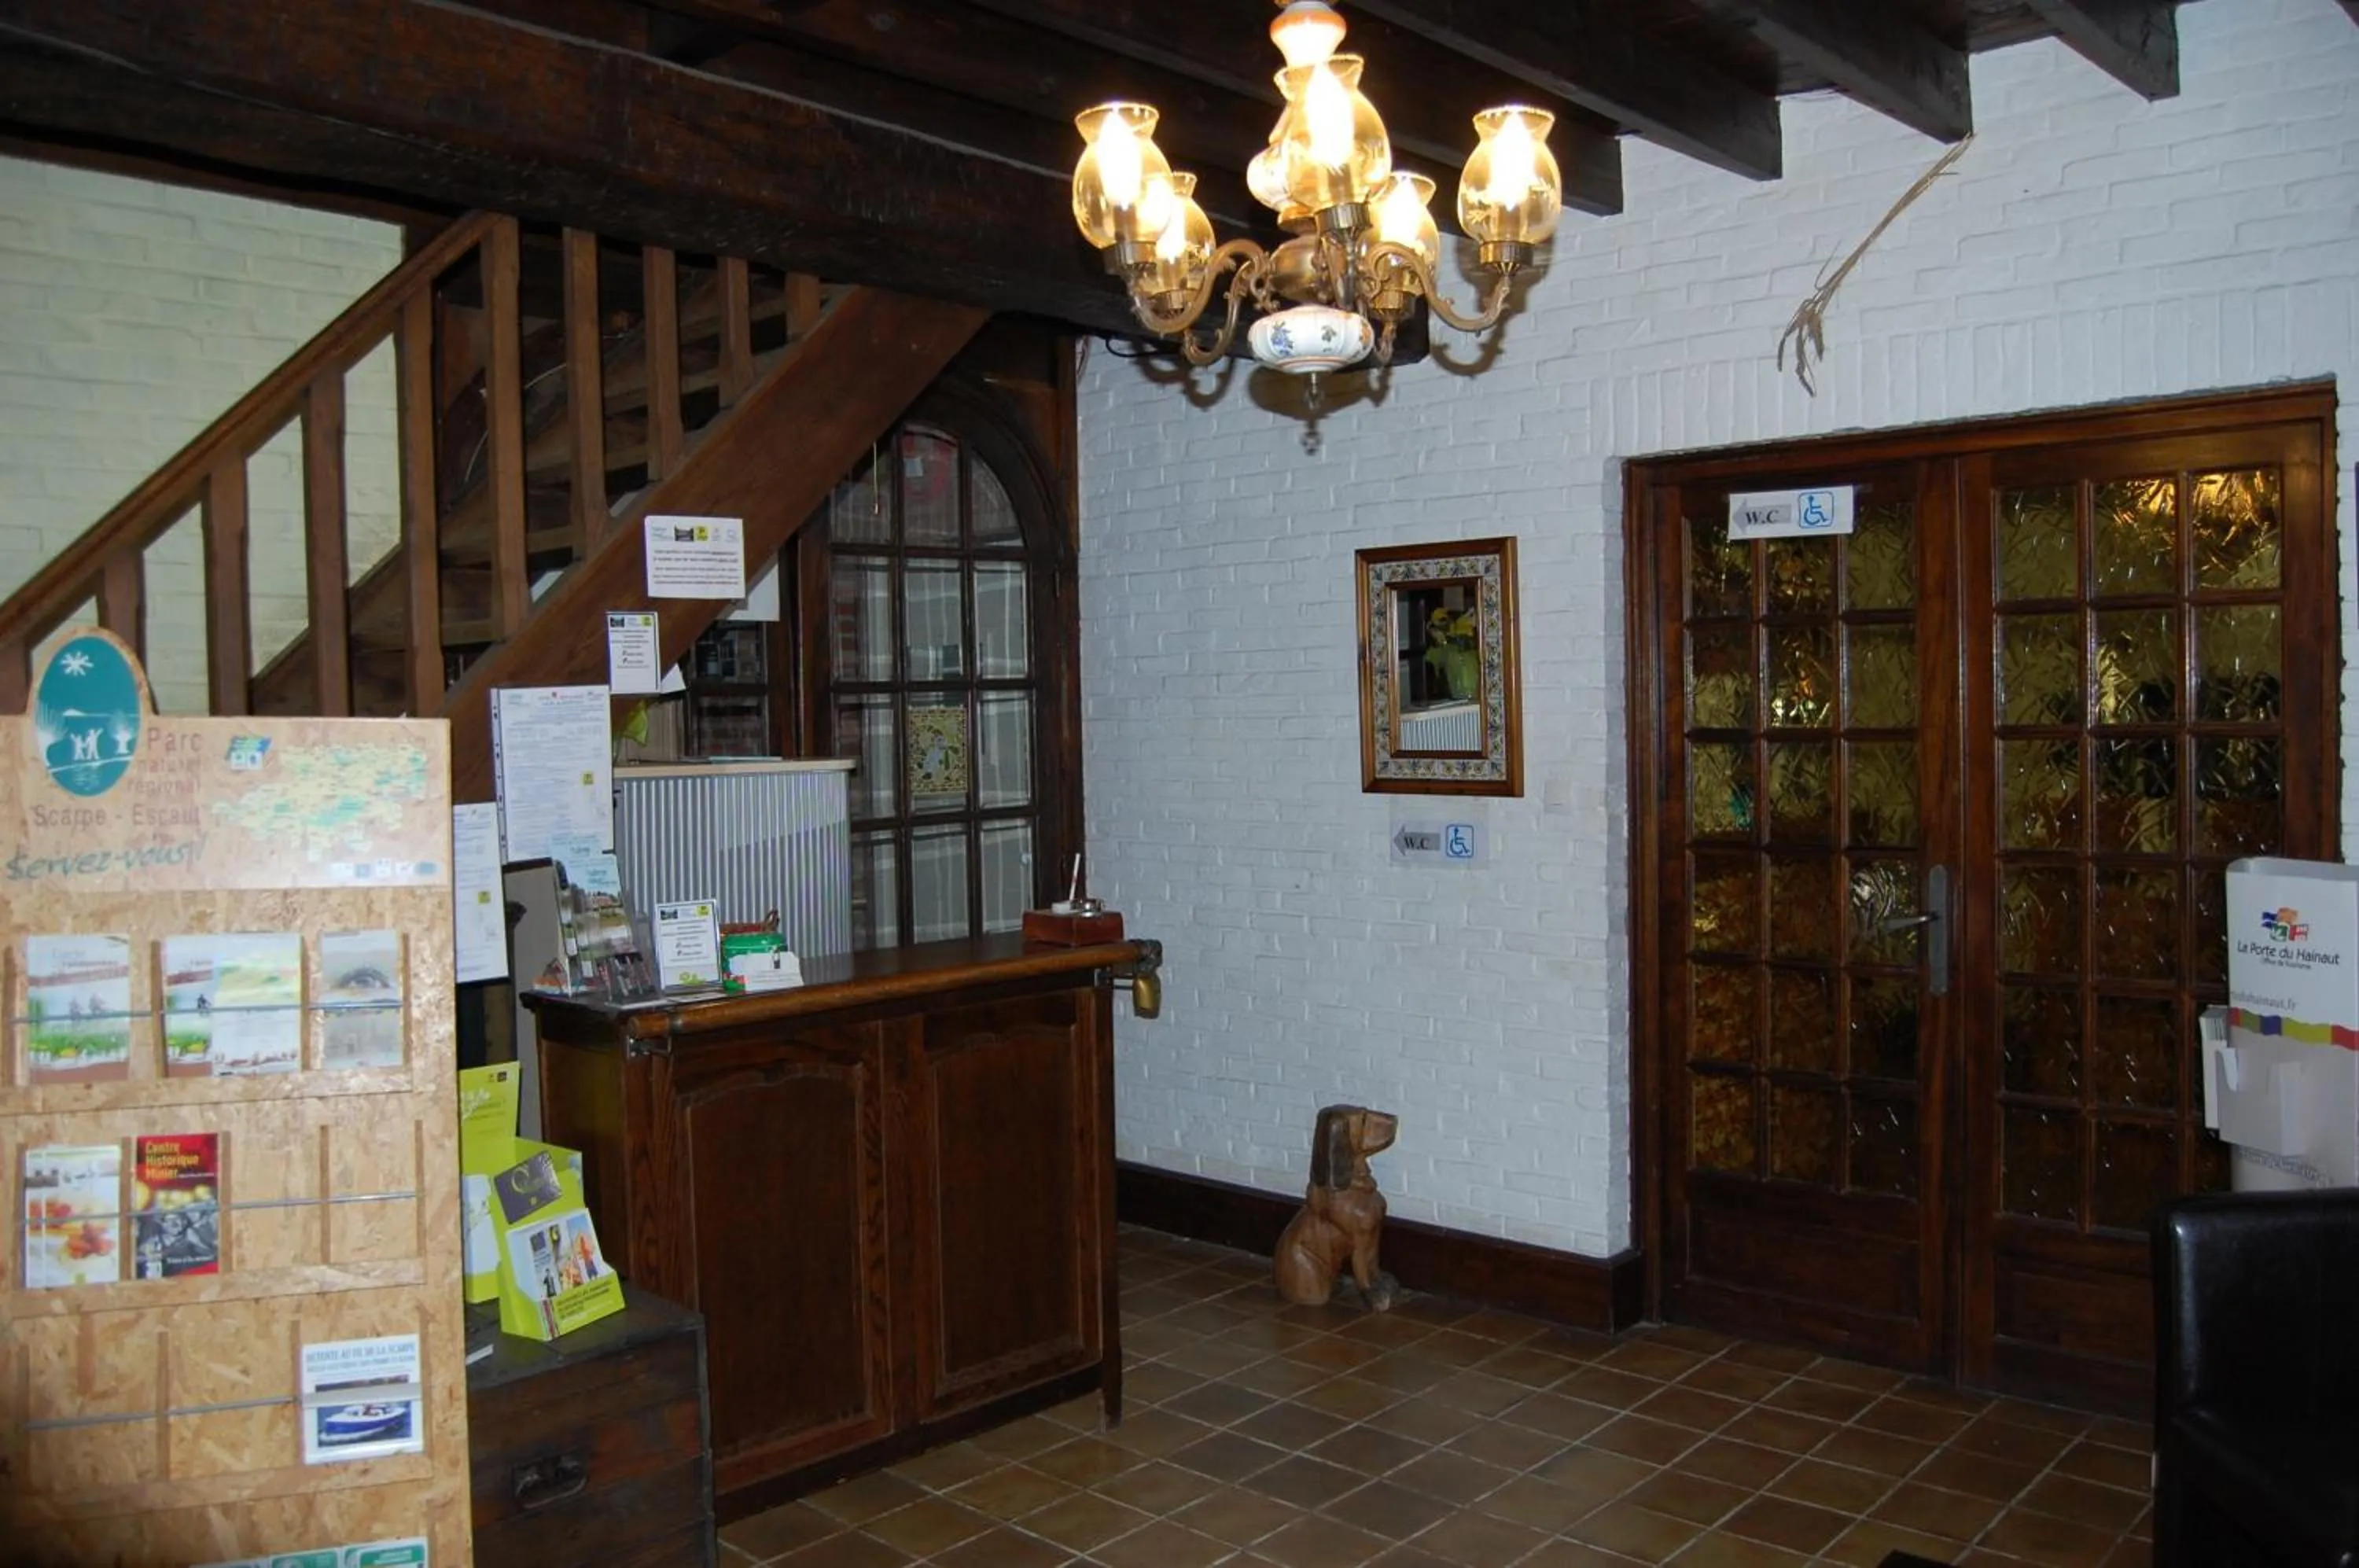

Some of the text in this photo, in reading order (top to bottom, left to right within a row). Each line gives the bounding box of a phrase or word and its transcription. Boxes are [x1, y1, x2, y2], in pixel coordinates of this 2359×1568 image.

[147, 727, 203, 752] Parc
[32, 804, 107, 830] Scarpe
[132, 803, 200, 826] Escaut
[2237, 941, 2340, 965] La Porte du Hainaut
[145, 1142, 181, 1154] Centre
[145, 1154, 199, 1168] Historique
